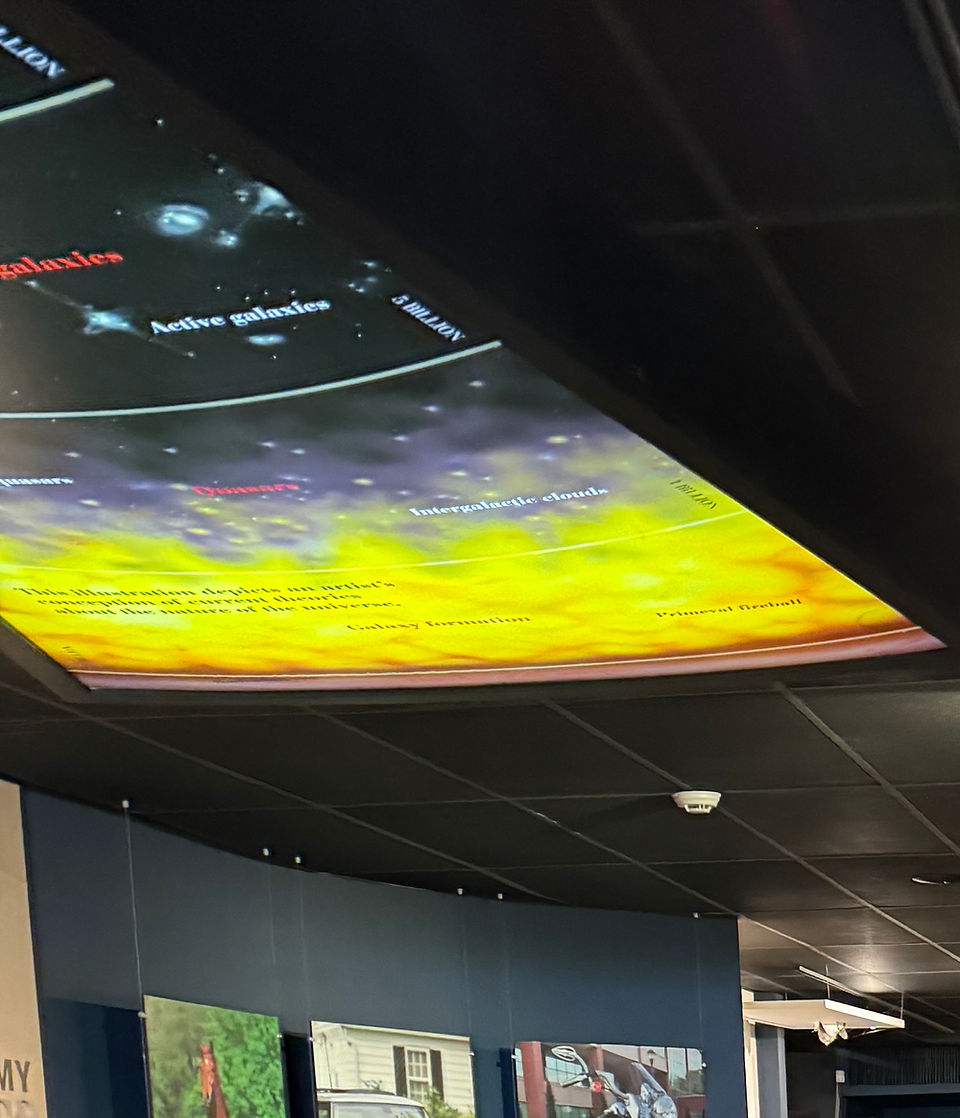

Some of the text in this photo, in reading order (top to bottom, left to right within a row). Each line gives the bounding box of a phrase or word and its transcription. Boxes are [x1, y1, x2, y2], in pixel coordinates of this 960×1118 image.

[0, 251, 123, 280] galaxies
[150, 299, 331, 335] Active galaxies
[391, 294, 467, 343] 5 BILLION
[192, 483, 299, 497] Quasars
[409, 486, 608, 518] Intergalactic clouds
[12, 587, 69, 596] This
[69, 588, 196, 597] illustration
[201, 586, 281, 597] depicts
[321, 580, 396, 590] artist's
[37, 593, 362, 608] conception of current theories
[738, 598, 802, 611] fireball
[54, 607, 117, 615] about
[120, 608, 153, 616] the
[262, 605, 296, 613] the
[302, 602, 402, 611] universe.
[346, 616, 531, 630] Galaxy formation
